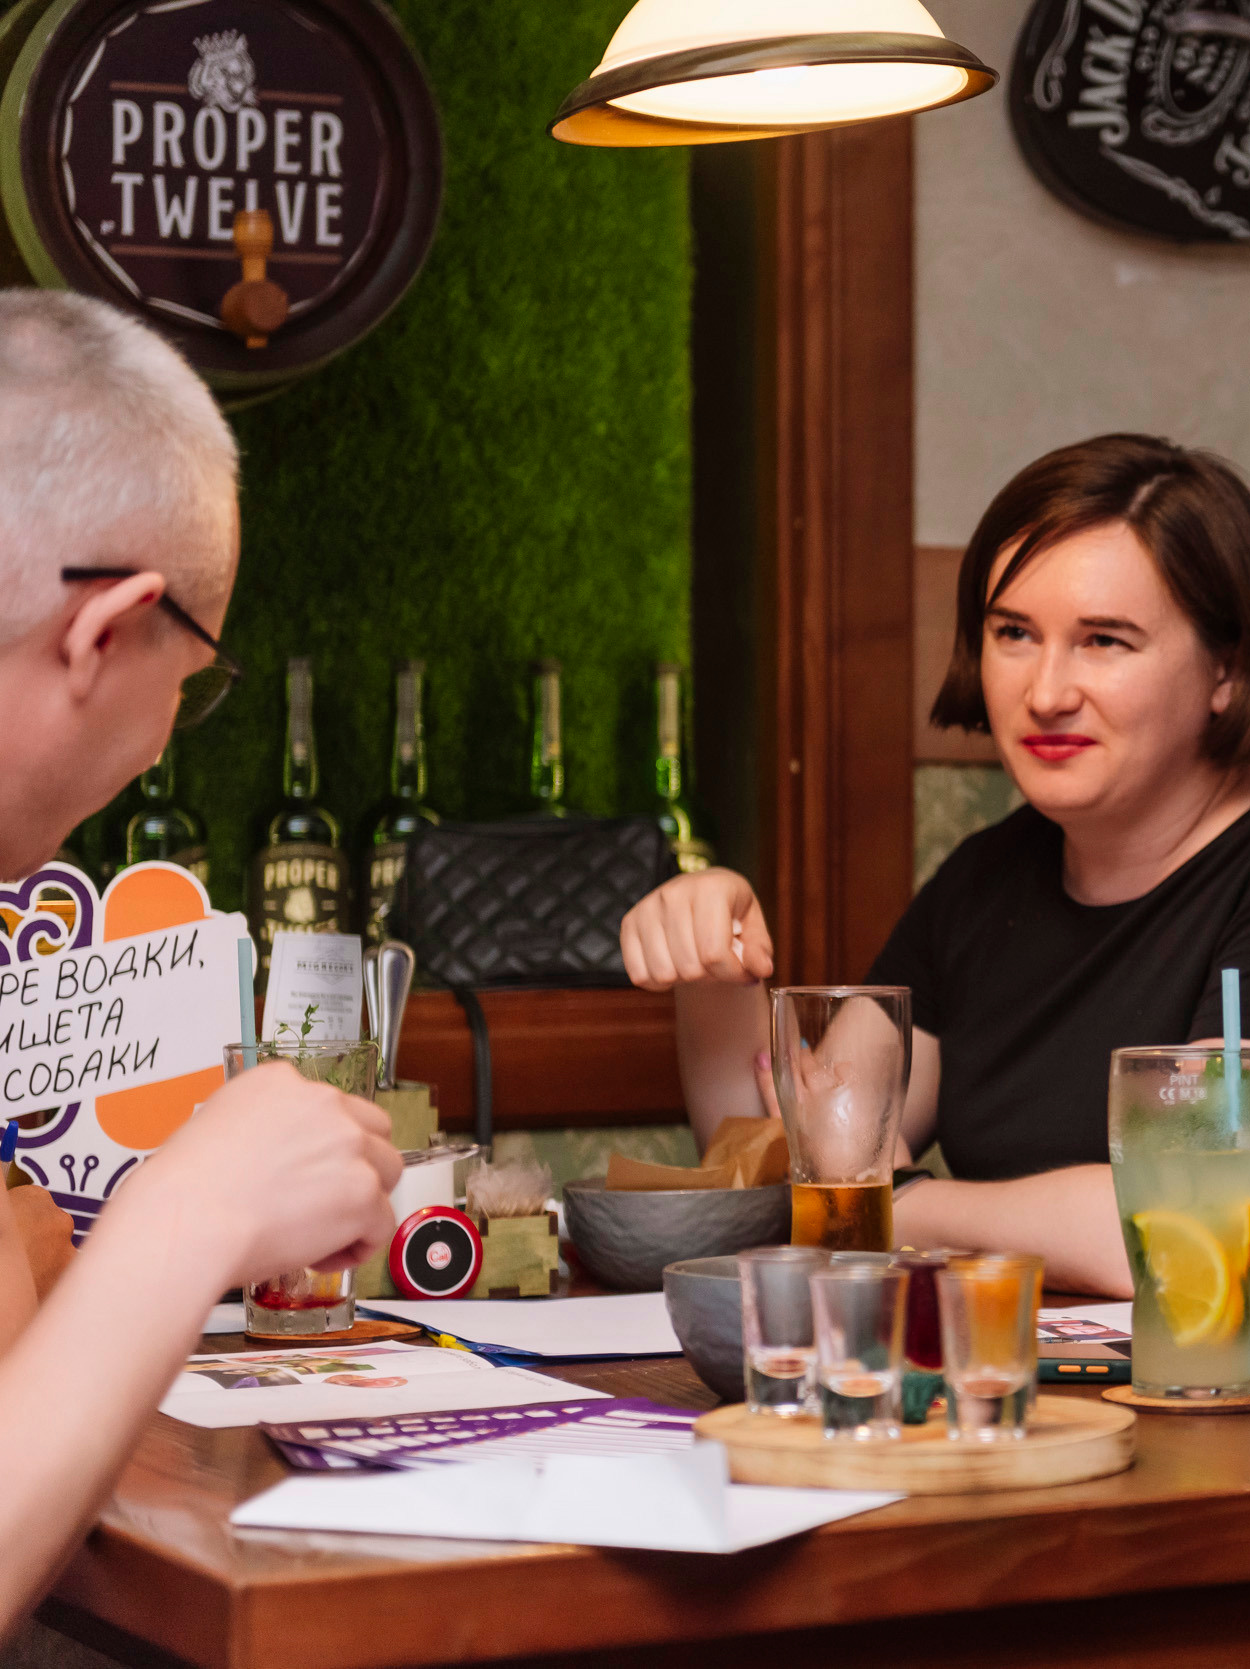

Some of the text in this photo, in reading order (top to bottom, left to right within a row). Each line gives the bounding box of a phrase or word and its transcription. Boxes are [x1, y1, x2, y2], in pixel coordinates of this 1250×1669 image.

[111, 98, 345, 178] PROPER
[55, 928, 205, 1001] ВОДКИ,
[3, 1036, 160, 1102] СОБАКИ
[1169, 1075, 1199, 1086] PINT
